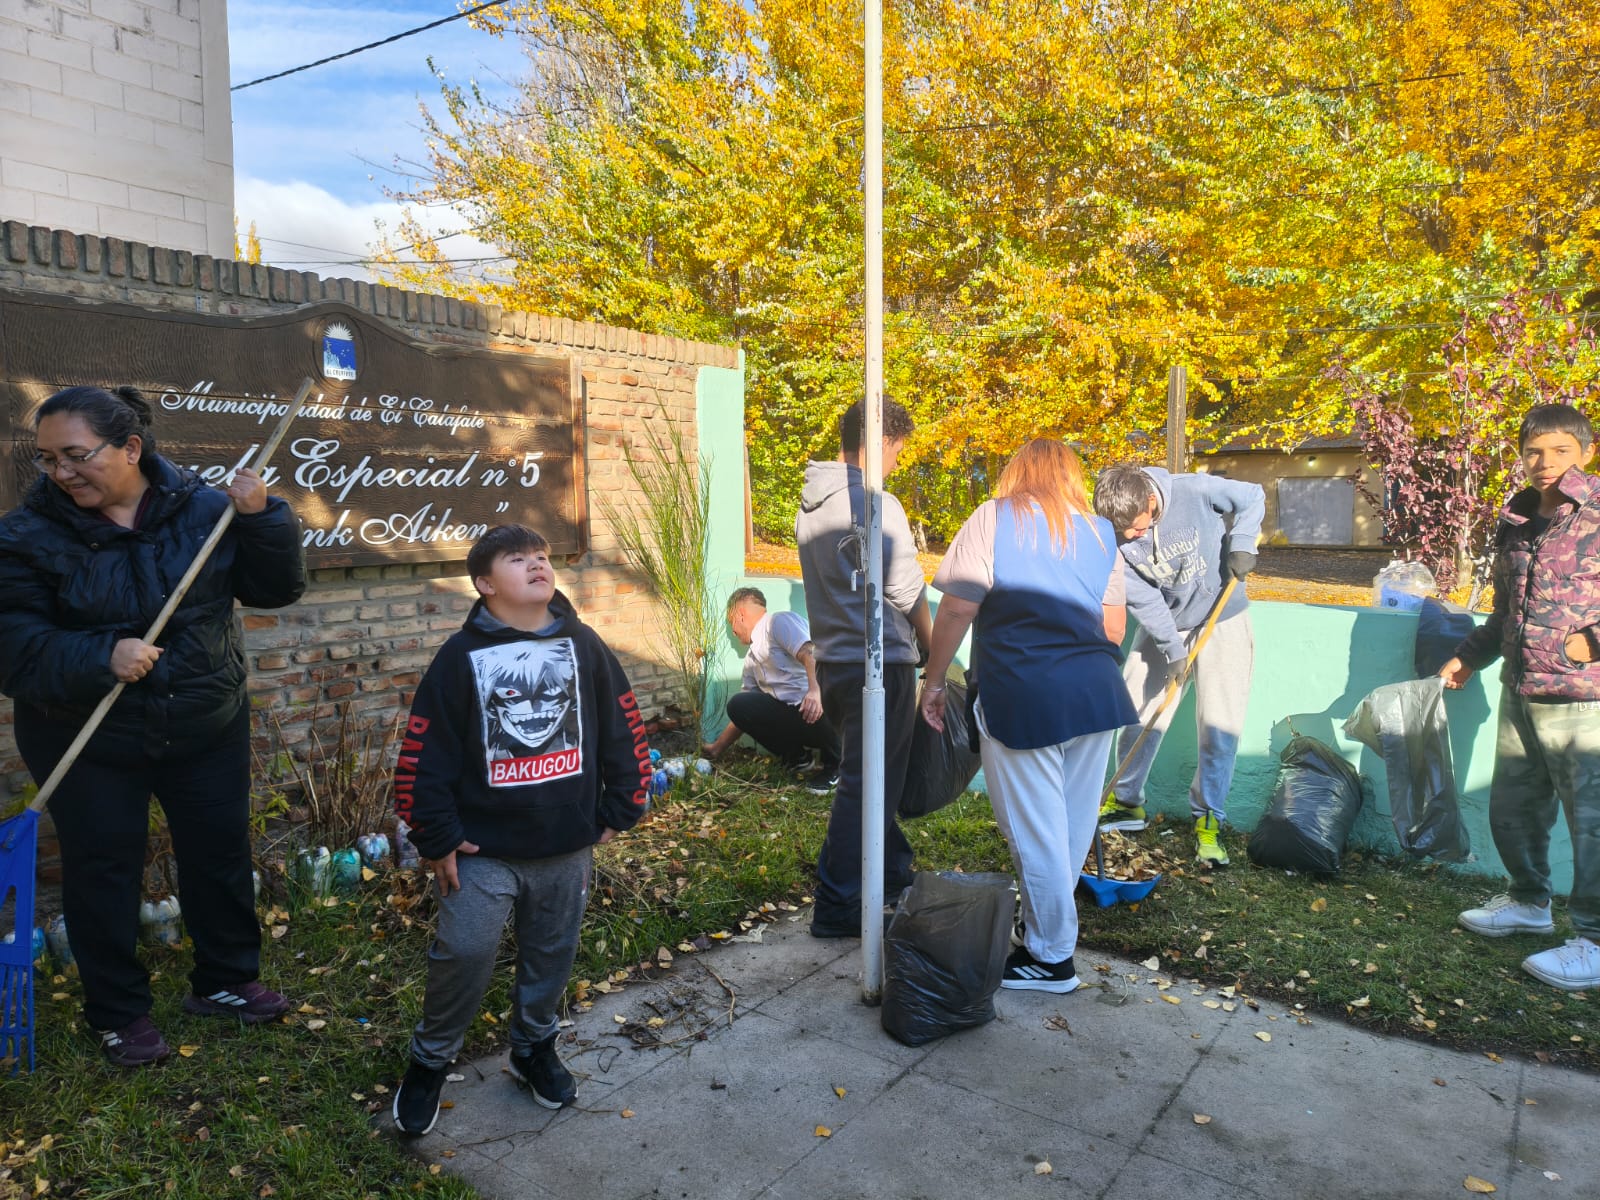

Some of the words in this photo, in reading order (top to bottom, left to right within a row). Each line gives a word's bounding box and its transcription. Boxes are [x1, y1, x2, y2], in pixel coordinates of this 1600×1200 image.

[350, 397, 372, 421] de
[378, 394, 402, 425] El
[409, 397, 485, 435] Calafate
[290, 437, 480, 503] Especial
[492, 752, 578, 782] BAKUGOU
